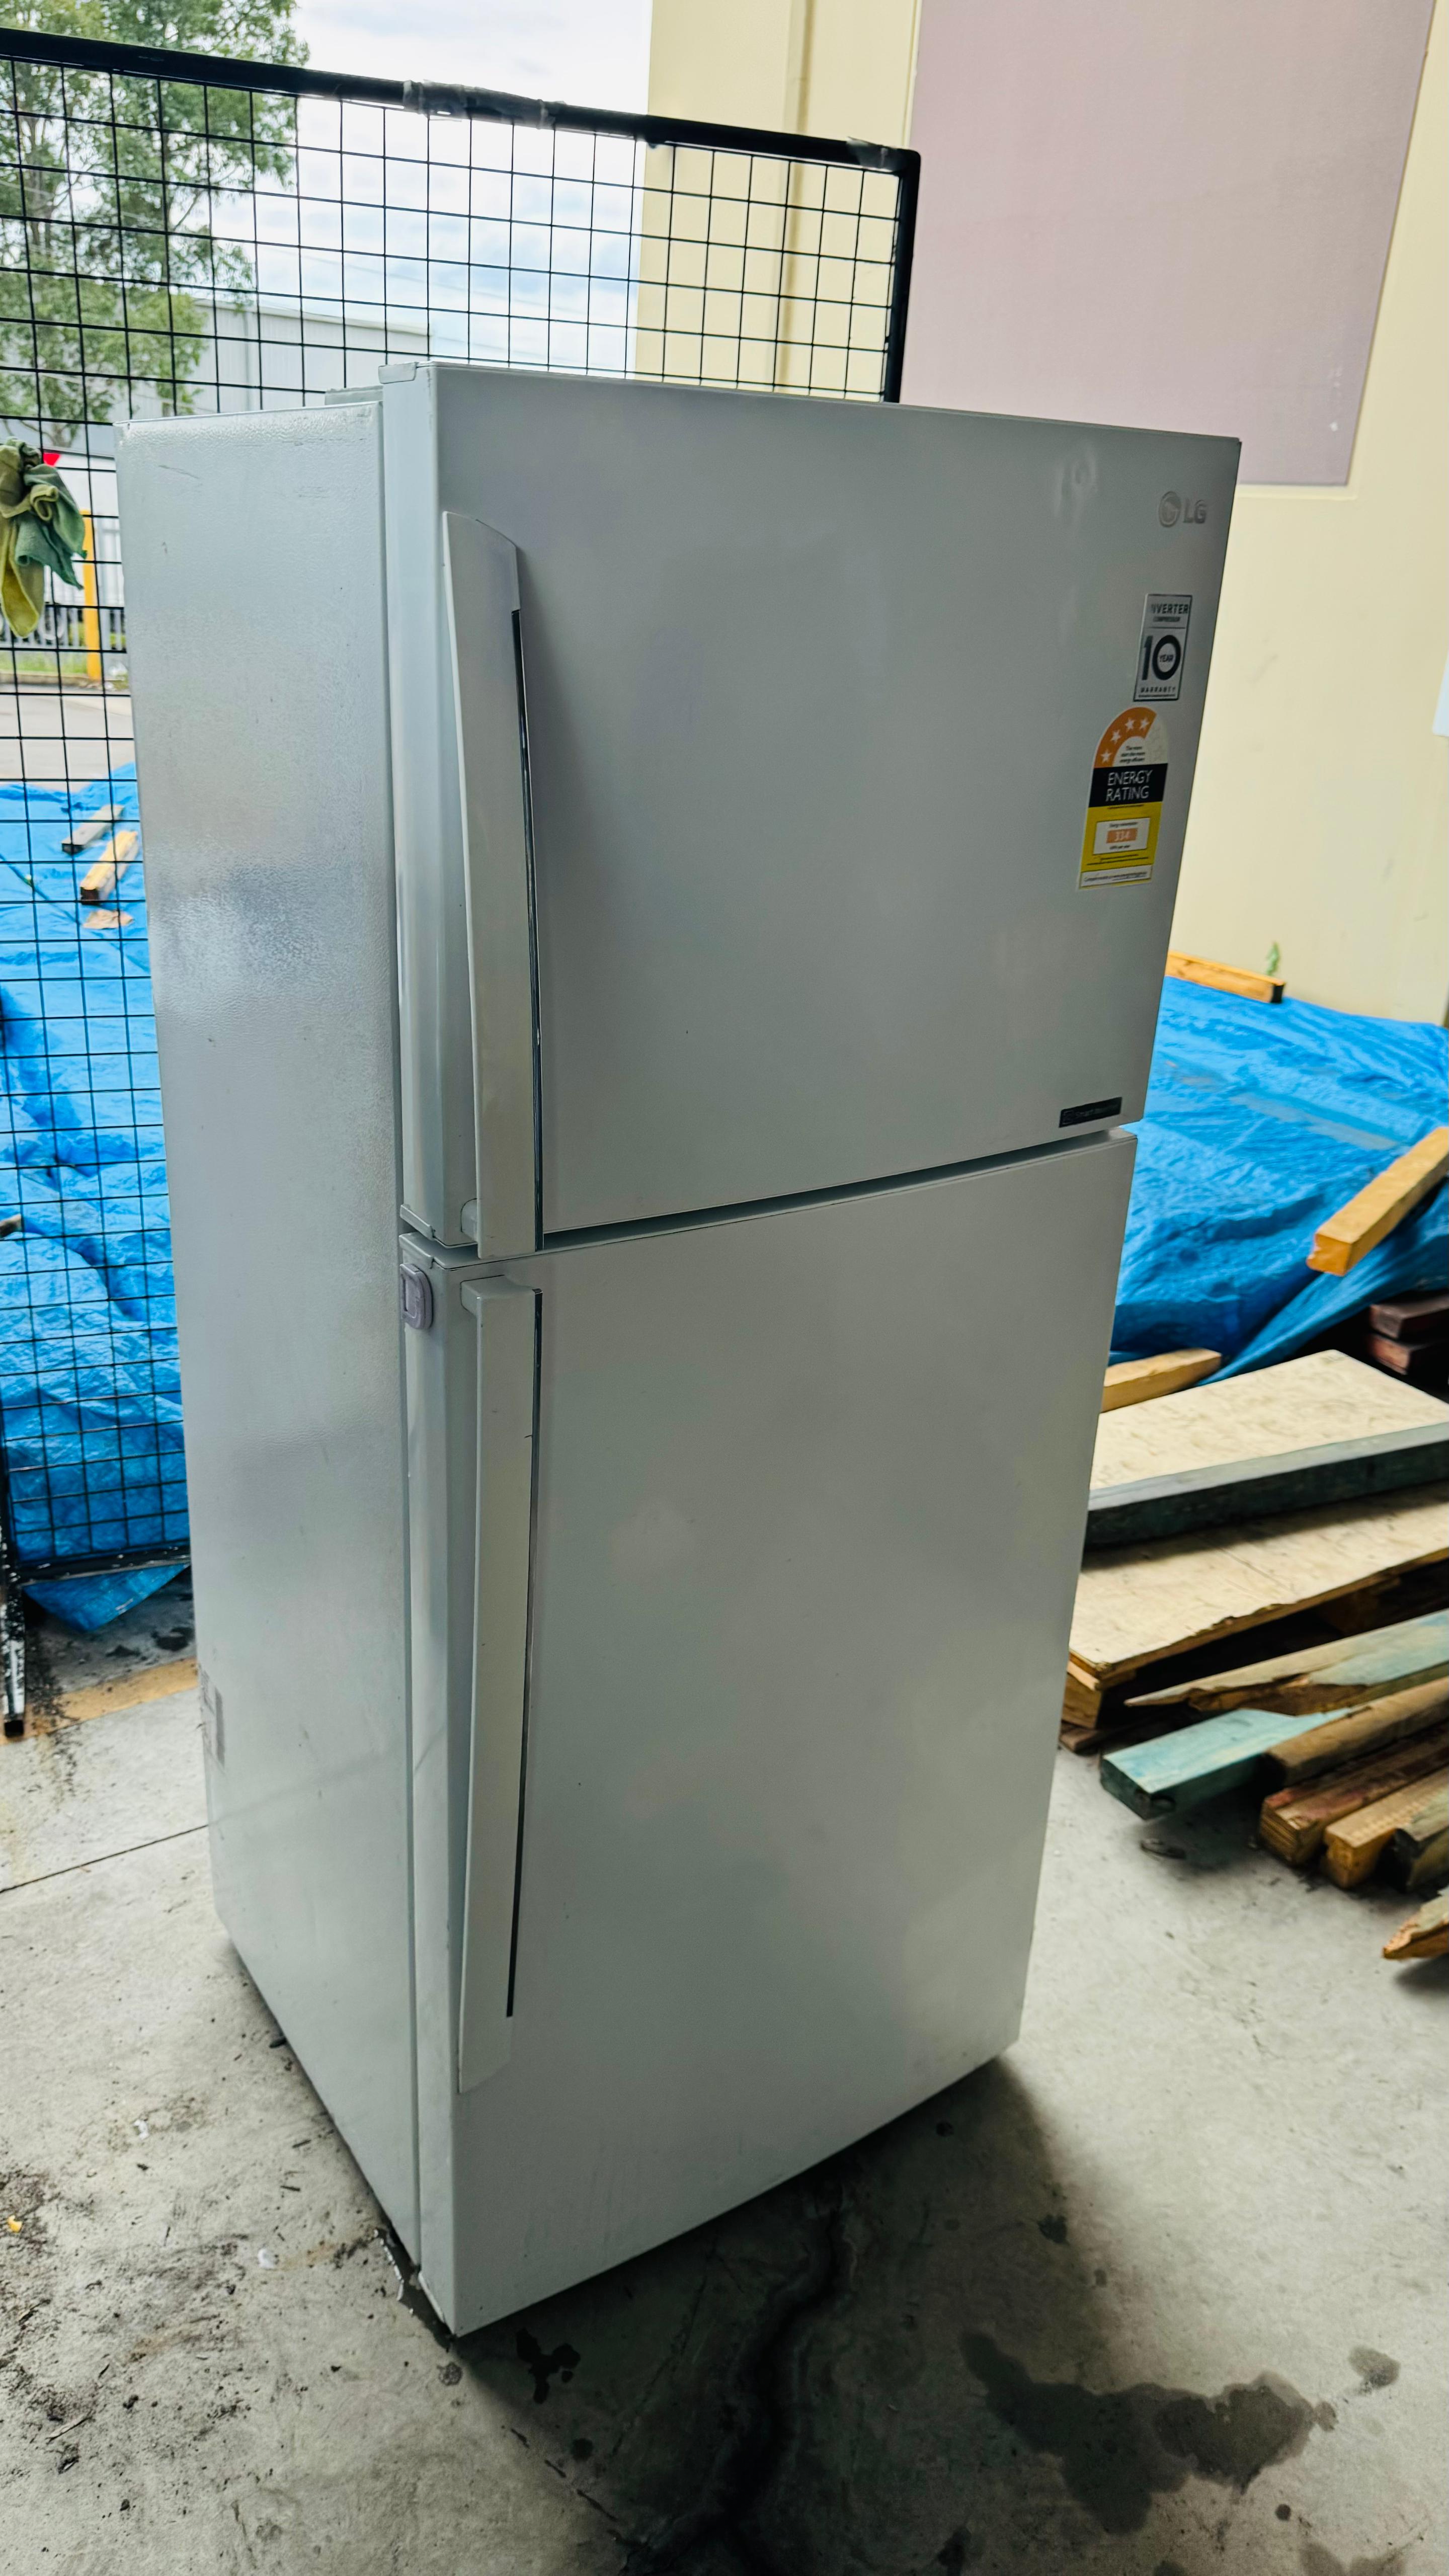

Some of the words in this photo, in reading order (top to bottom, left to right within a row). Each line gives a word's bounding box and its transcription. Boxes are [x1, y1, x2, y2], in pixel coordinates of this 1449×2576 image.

[1183, 499, 1208, 524] LG
[1150, 603, 1189, 614] NVERTER
[1141, 634, 1181, 681] 10
[1159, 654, 1174, 663] YEAR
[1107, 769, 1153, 786] ENERGY
[1105, 785, 1150, 801] RATING
